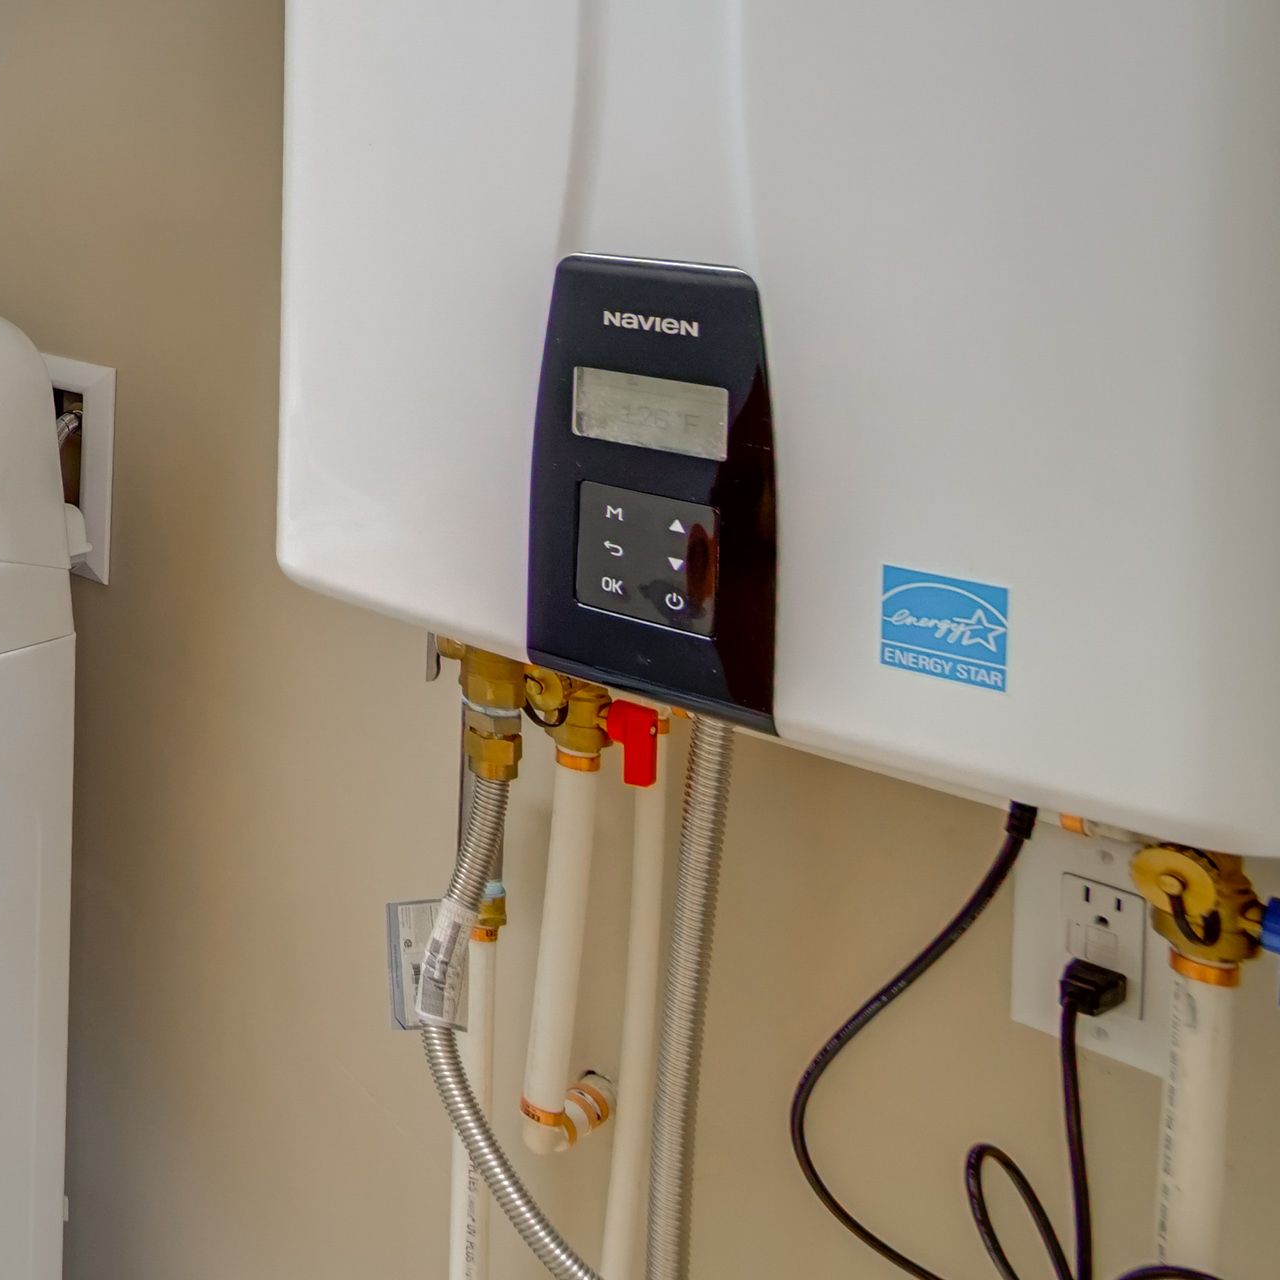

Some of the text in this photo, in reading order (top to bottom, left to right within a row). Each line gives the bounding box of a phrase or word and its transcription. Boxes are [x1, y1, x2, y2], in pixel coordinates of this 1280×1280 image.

[605, 504, 624, 521] M
[601, 576, 624, 595] OK
[891, 608, 964, 644] energy
[883, 646, 1004, 687] ENERGY STAR
